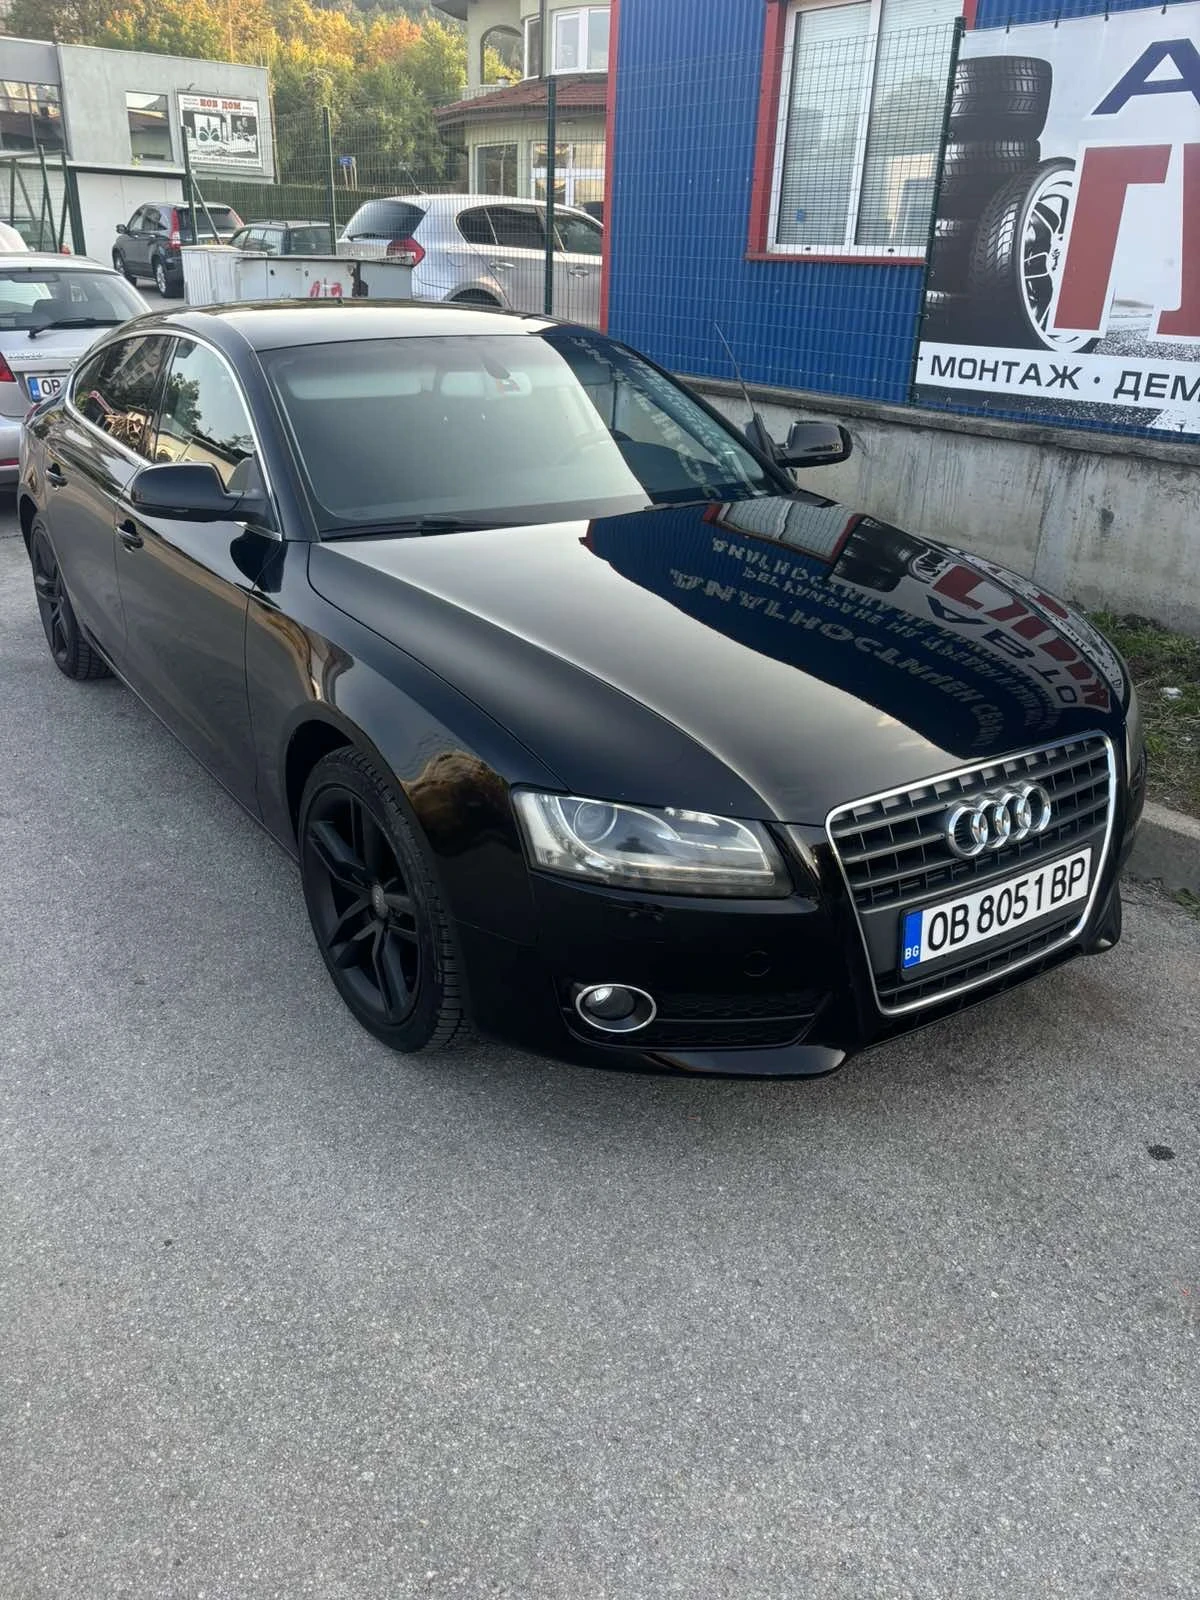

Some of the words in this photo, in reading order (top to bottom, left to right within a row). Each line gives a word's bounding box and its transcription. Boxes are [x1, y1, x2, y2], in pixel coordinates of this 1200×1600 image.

[930, 354, 1083, 391] МОНТАЖ
[927, 903, 970, 952] OB
[976, 872, 1045, 936] 8051
[1050, 856, 1086, 905] BP
[904, 944, 920, 961] BG
